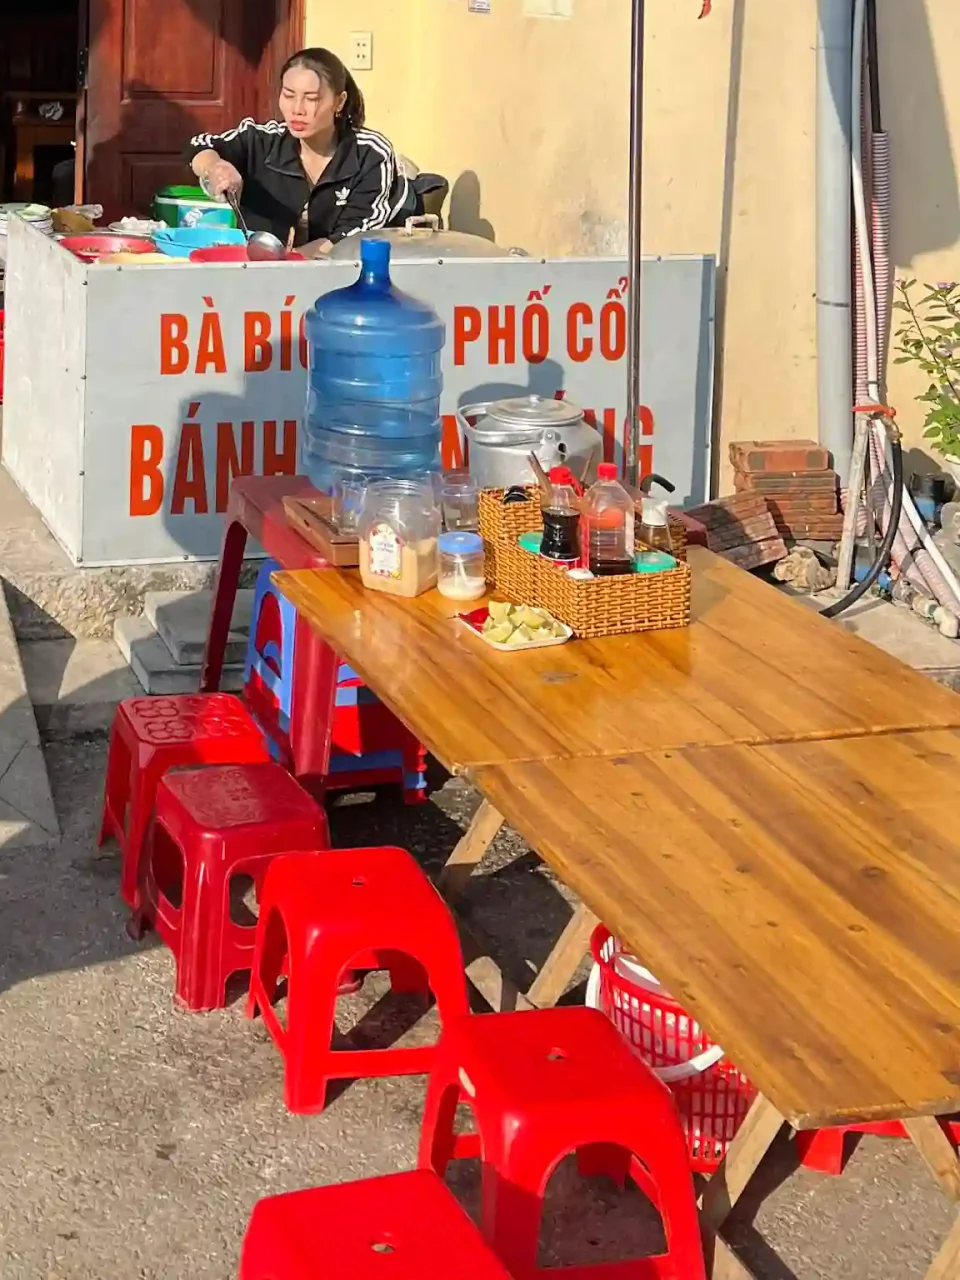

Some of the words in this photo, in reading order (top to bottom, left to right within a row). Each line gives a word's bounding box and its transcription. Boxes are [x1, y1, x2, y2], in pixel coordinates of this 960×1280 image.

[159, 297, 228, 375] BÀ
[454, 284, 550, 366] PHỐ
[566, 276, 630, 363] CỔ
[129, 401, 298, 517] BÁNH
